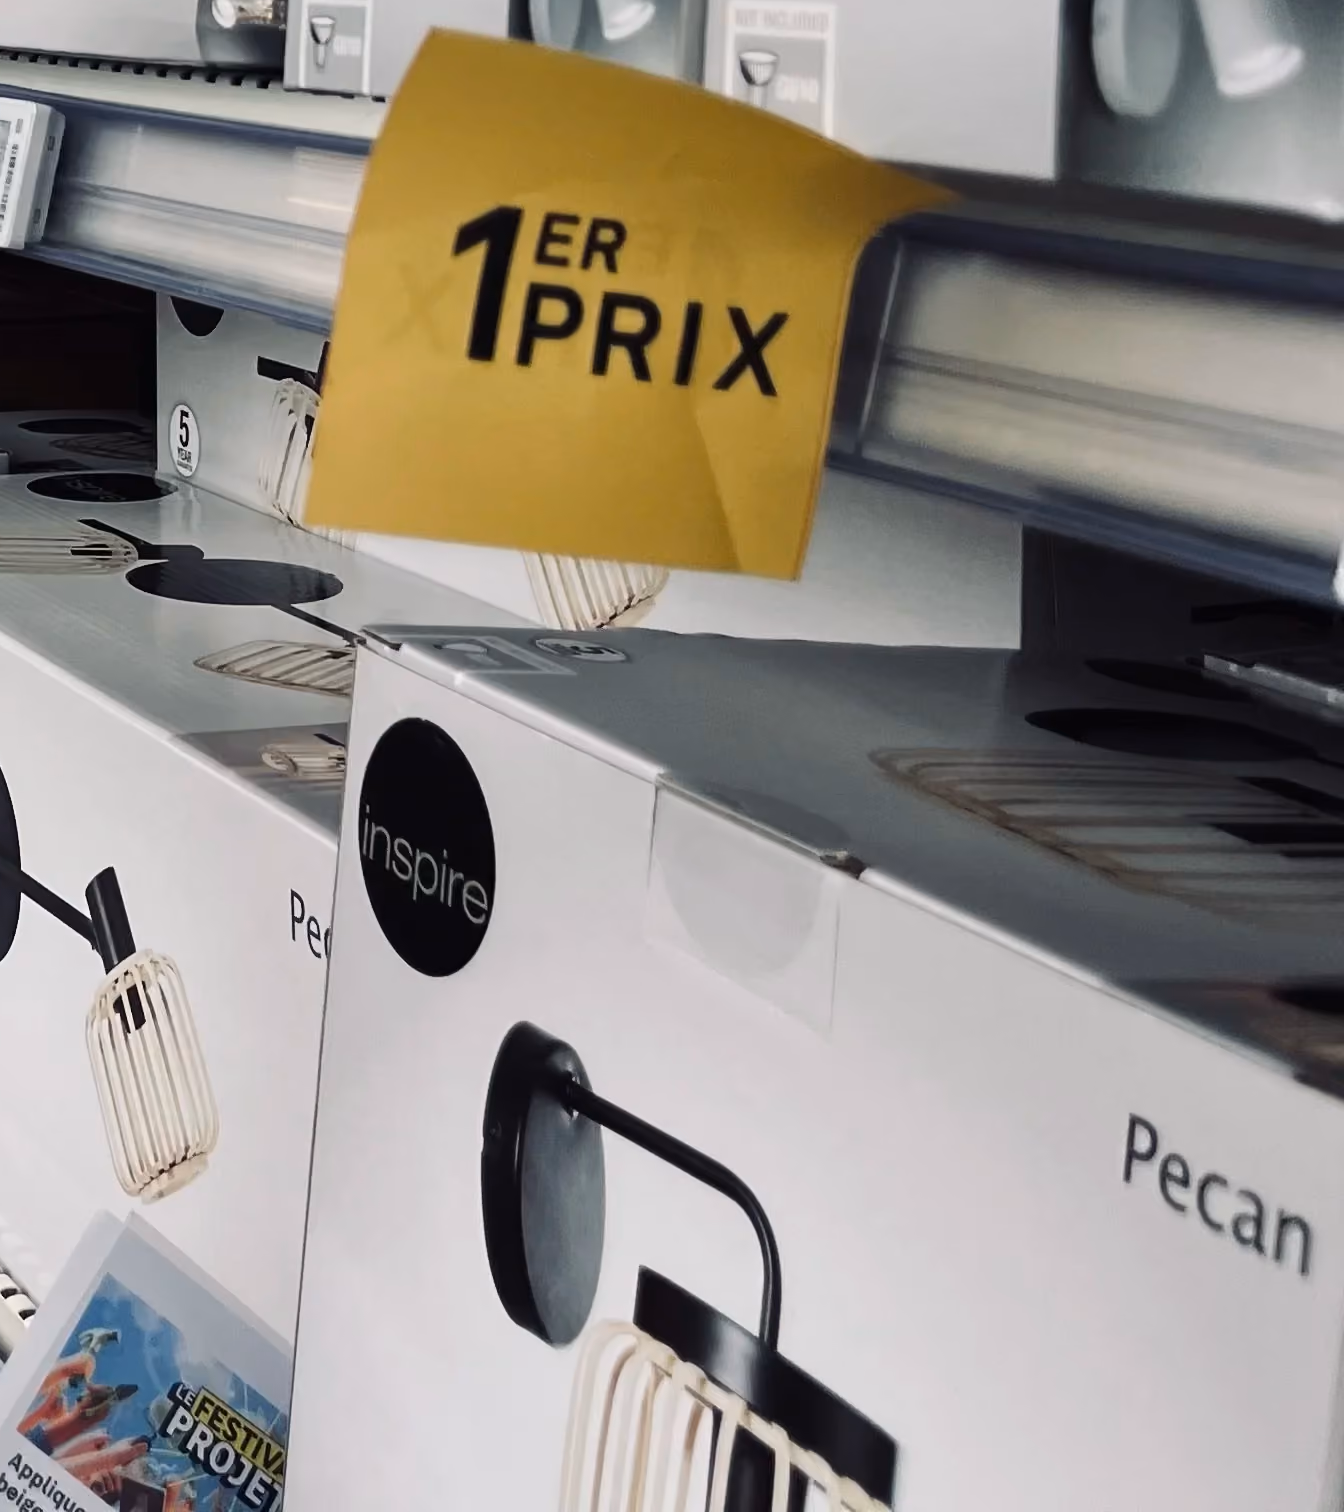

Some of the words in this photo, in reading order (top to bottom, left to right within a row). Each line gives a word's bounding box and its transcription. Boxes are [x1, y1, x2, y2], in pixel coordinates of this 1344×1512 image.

[515, 281, 790, 398] PRIX
[179, 409, 190, 448] 5
[362, 804, 488, 924] inspire
[1123, 1112, 1312, 1277] Pecan
[177, 1384, 195, 1407] LE
